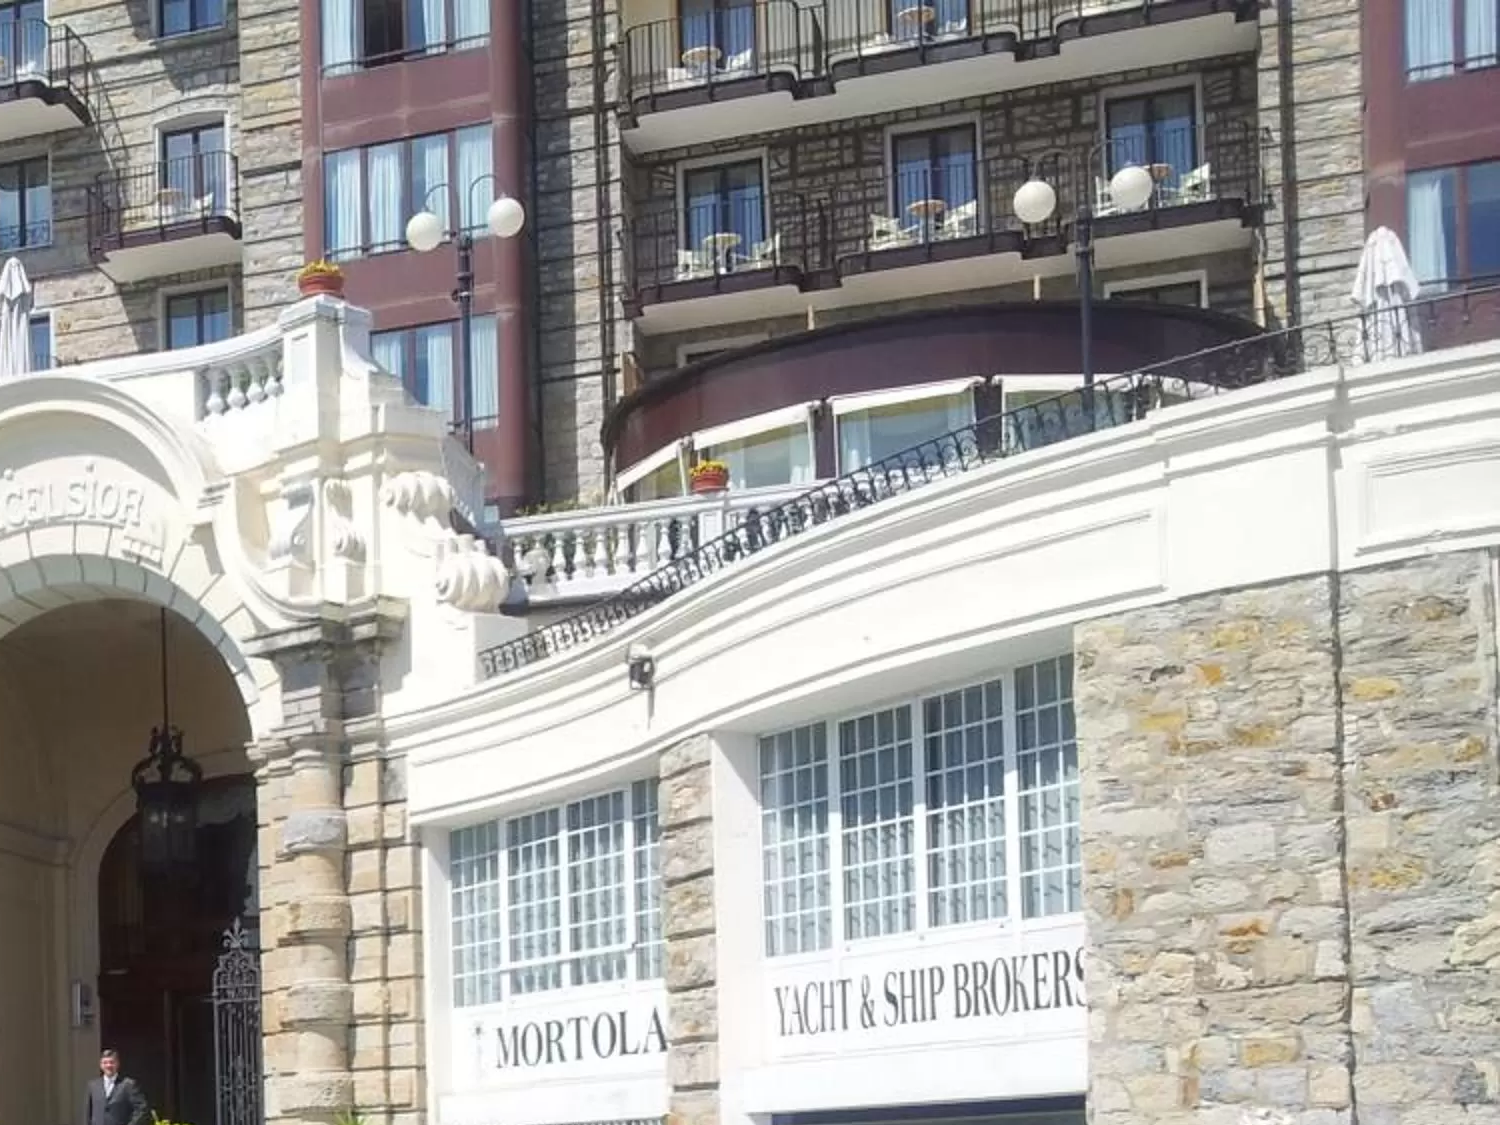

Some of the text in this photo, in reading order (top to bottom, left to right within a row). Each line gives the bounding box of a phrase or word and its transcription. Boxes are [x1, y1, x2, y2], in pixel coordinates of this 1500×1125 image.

[774, 946, 1087, 1037] YACHT & SHIP BROKERS
[495, 1005, 668, 1069] MORTOLA
